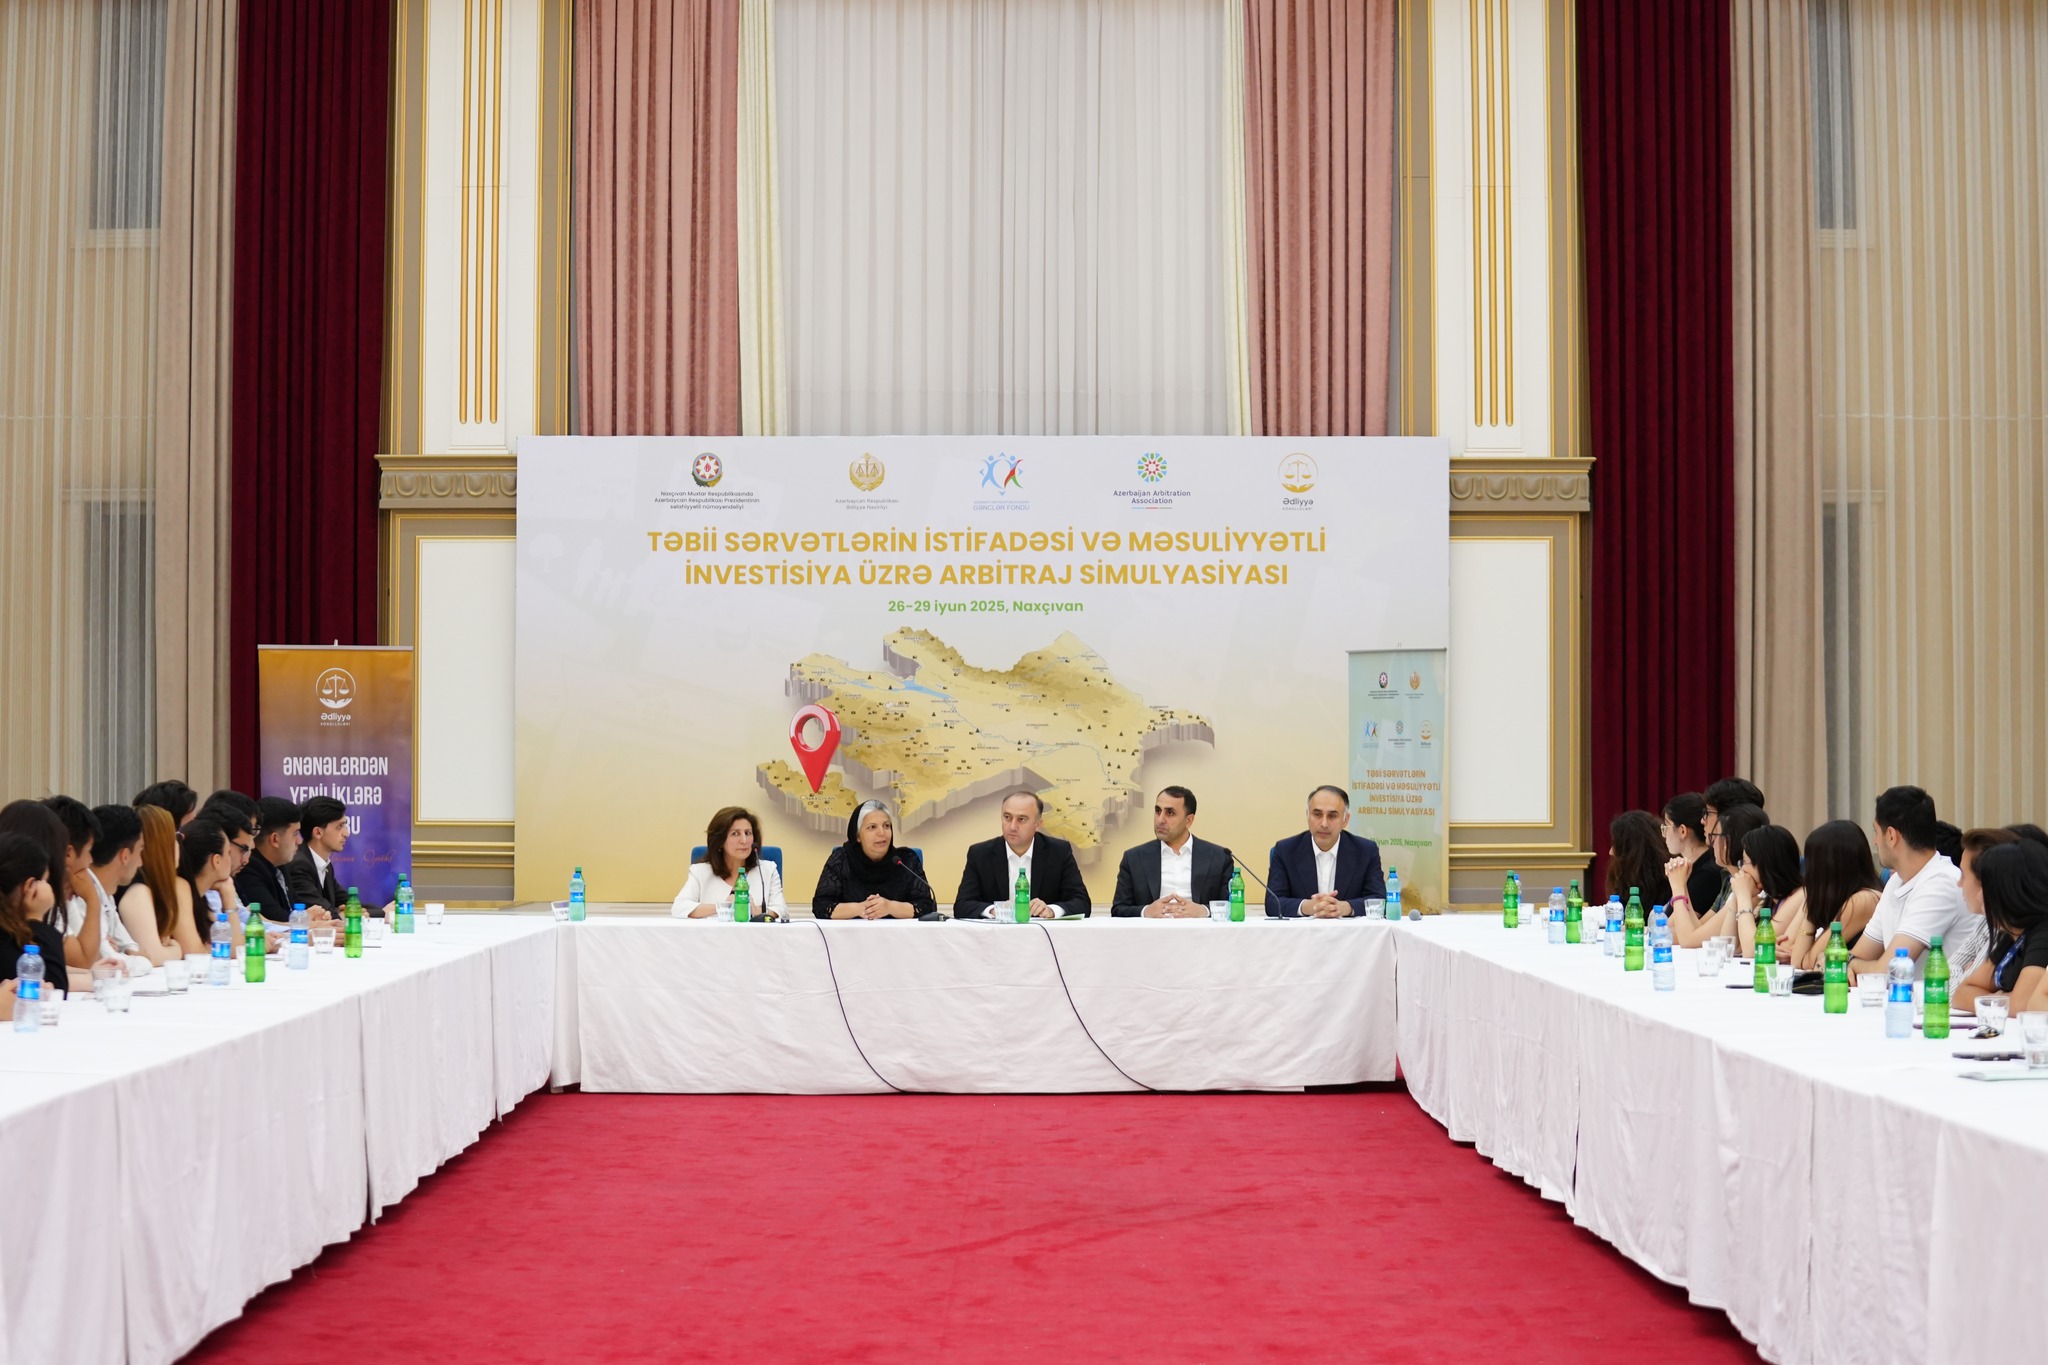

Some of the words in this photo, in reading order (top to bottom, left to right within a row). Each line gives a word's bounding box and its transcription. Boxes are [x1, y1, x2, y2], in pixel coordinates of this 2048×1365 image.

[1113, 490, 1151, 498] Azerbaijan
[1282, 497, 1314, 507] Ədliyyə
[647, 527, 717, 552] TƏBİİ
[725, 527, 917, 552] SƏRVƏTLƏRİN
[925, 526, 1073, 552] İSTİFADƏSİ
[1081, 531, 1121, 552] VƏ
[1129, 526, 1326, 552] MƏSULİYYƏTLİ
[686, 559, 851, 585] İNVESTİSİYA
[859, 559, 932, 585] ÜZRƏ
[939, 559, 1072, 585] ARBİTRAJ
[1080, 559, 1288, 585] SİMULYASİYASI
[888, 600, 930, 613] 26-29
[934, 600, 967, 615] iyun
[970, 600, 1009, 614] 2025,
[1013, 600, 1083, 616] Naxçıvan
[321, 712, 352, 722] Ədliyyə
[283, 756, 389, 776] ƏNƏNƏLƏRDƏN
